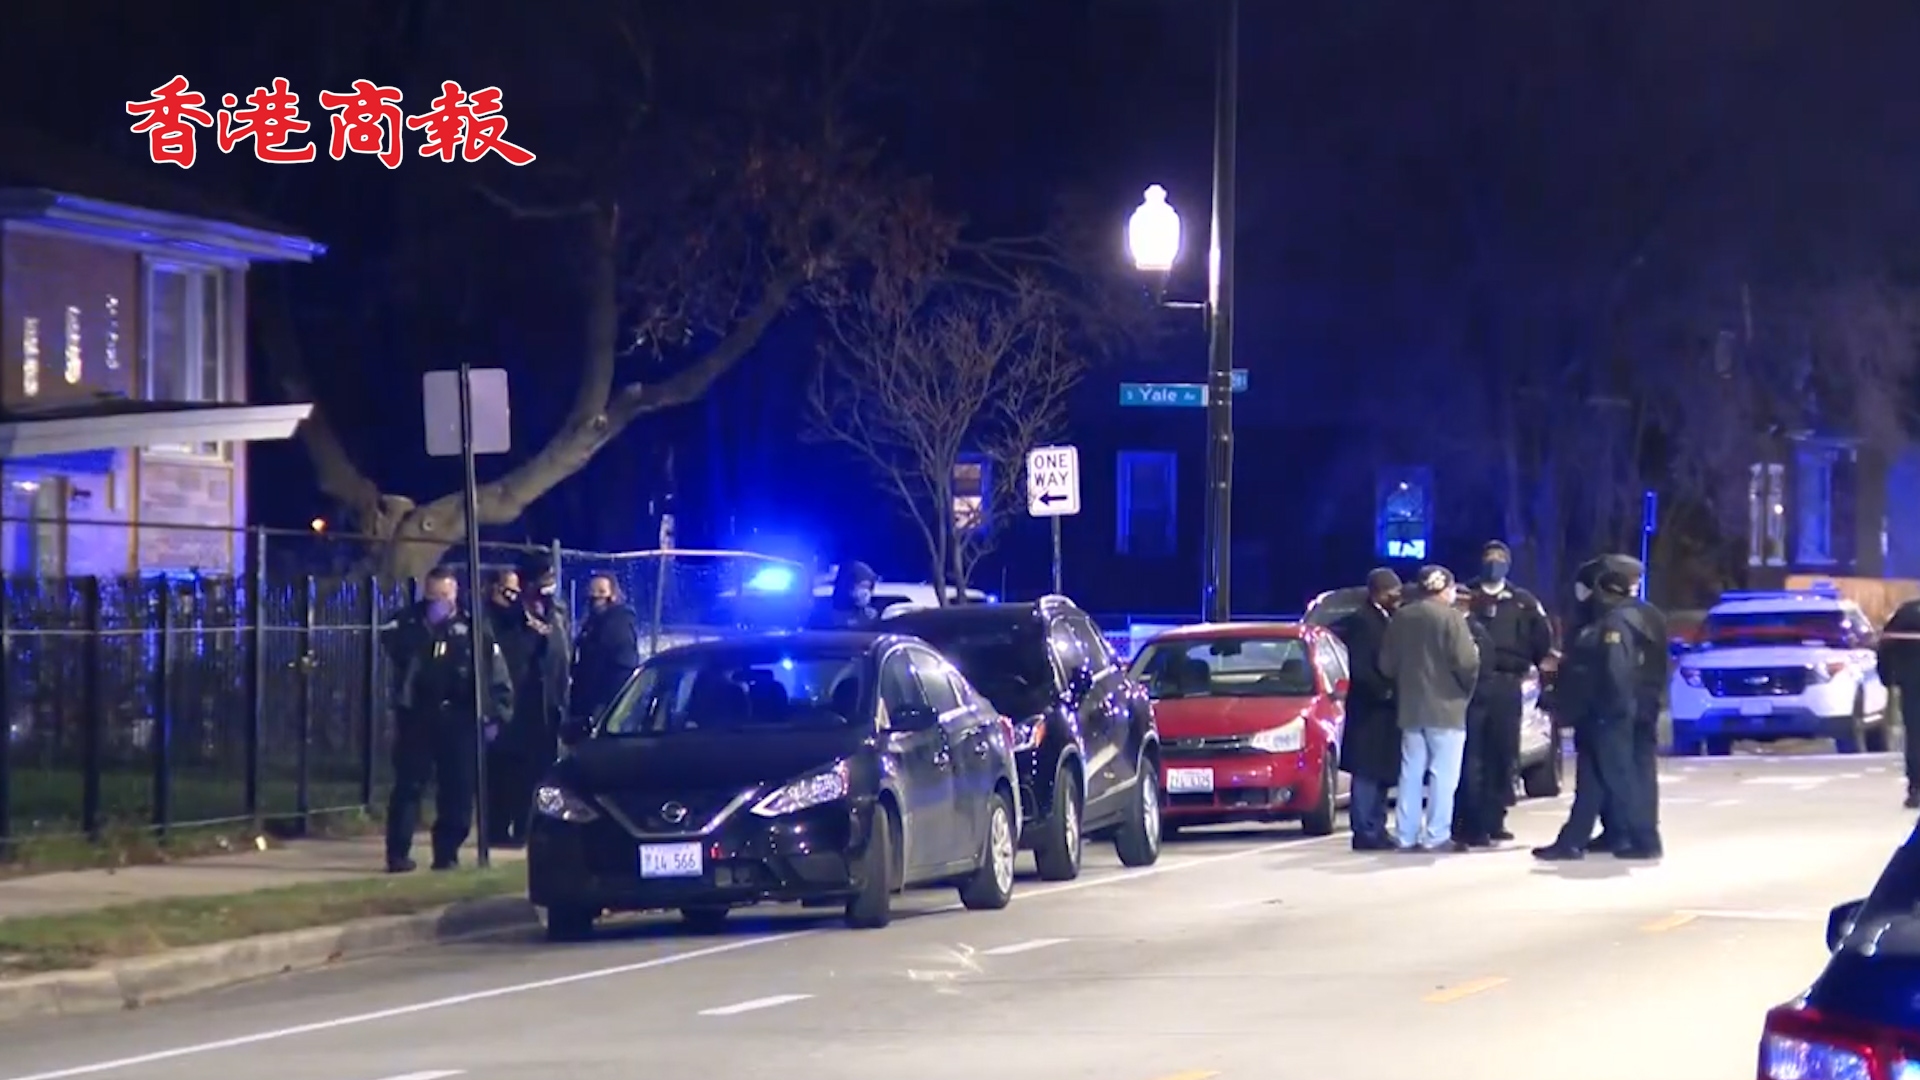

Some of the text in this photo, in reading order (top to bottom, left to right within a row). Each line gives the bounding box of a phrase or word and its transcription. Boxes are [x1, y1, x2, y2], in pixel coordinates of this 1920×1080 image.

[1138, 387, 1177, 402] Yale
[1034, 453, 1068, 469] ONE
[1034, 471, 1069, 487] WAY
